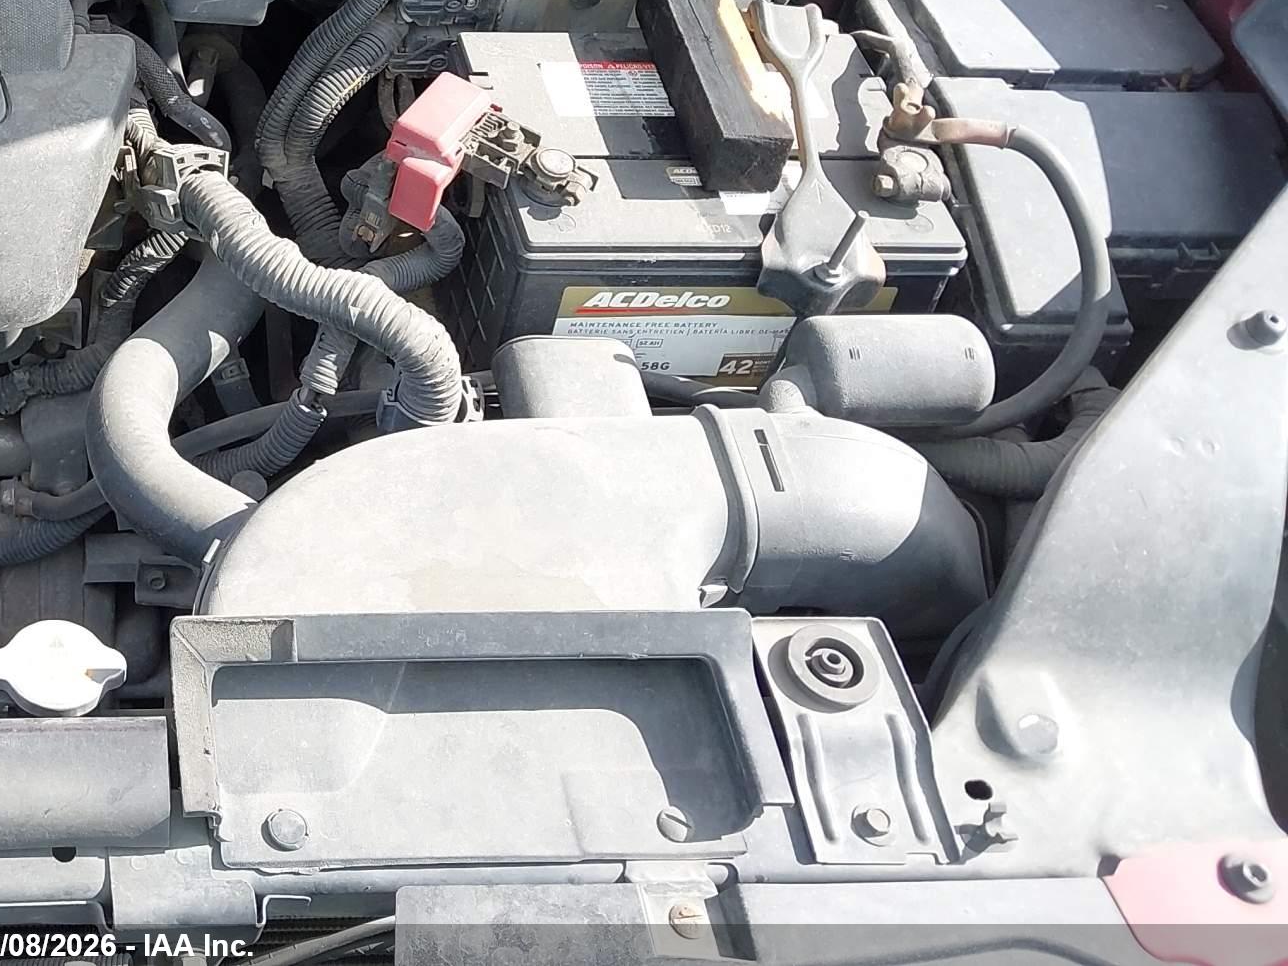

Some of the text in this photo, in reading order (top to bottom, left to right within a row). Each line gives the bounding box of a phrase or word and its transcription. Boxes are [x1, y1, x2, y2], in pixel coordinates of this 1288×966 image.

[583, 291, 731, 309] ACDelco
[641, 361, 671, 371] 58G
[719, 359, 754, 375] 42
